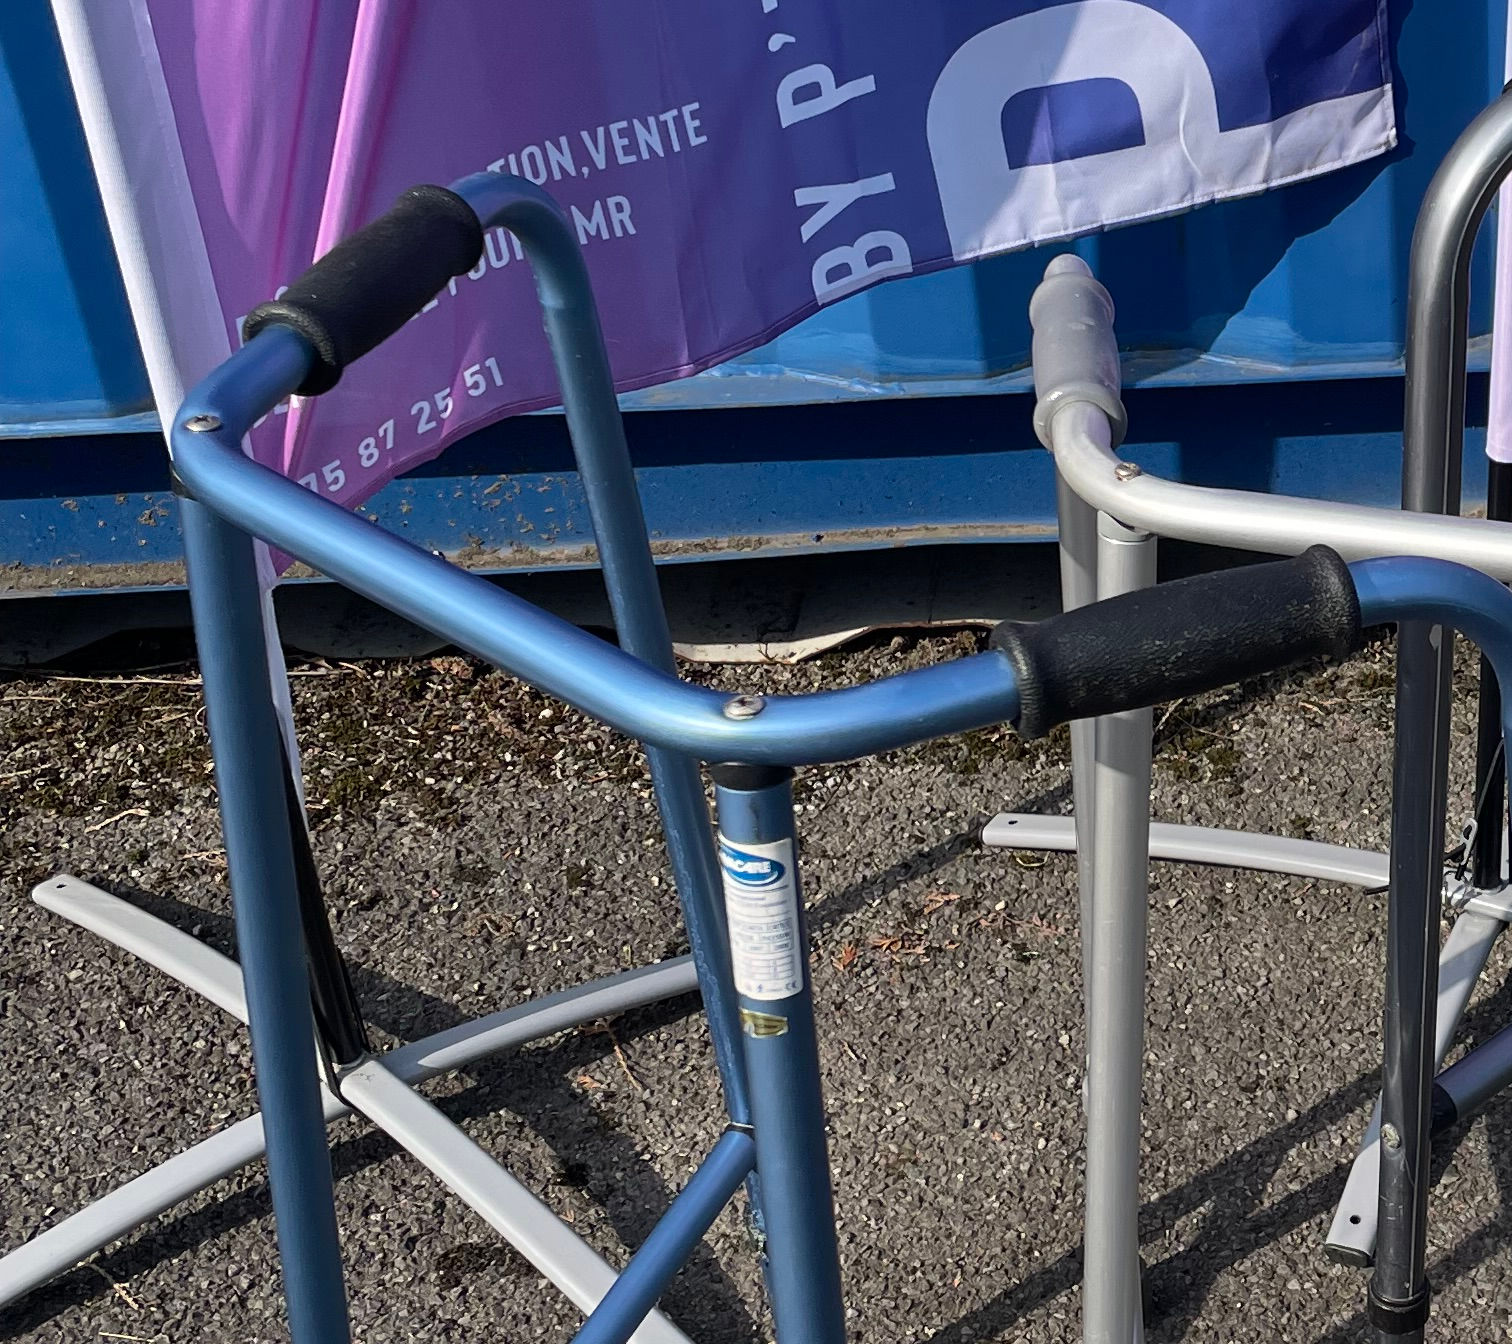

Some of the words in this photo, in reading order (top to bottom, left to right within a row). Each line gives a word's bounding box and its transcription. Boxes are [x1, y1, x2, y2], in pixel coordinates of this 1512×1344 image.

[794, 172, 913, 305] BY
[358, 419, 395, 468] 87
[410, 387, 454, 435] 25
[463, 357, 504, 398] 51
